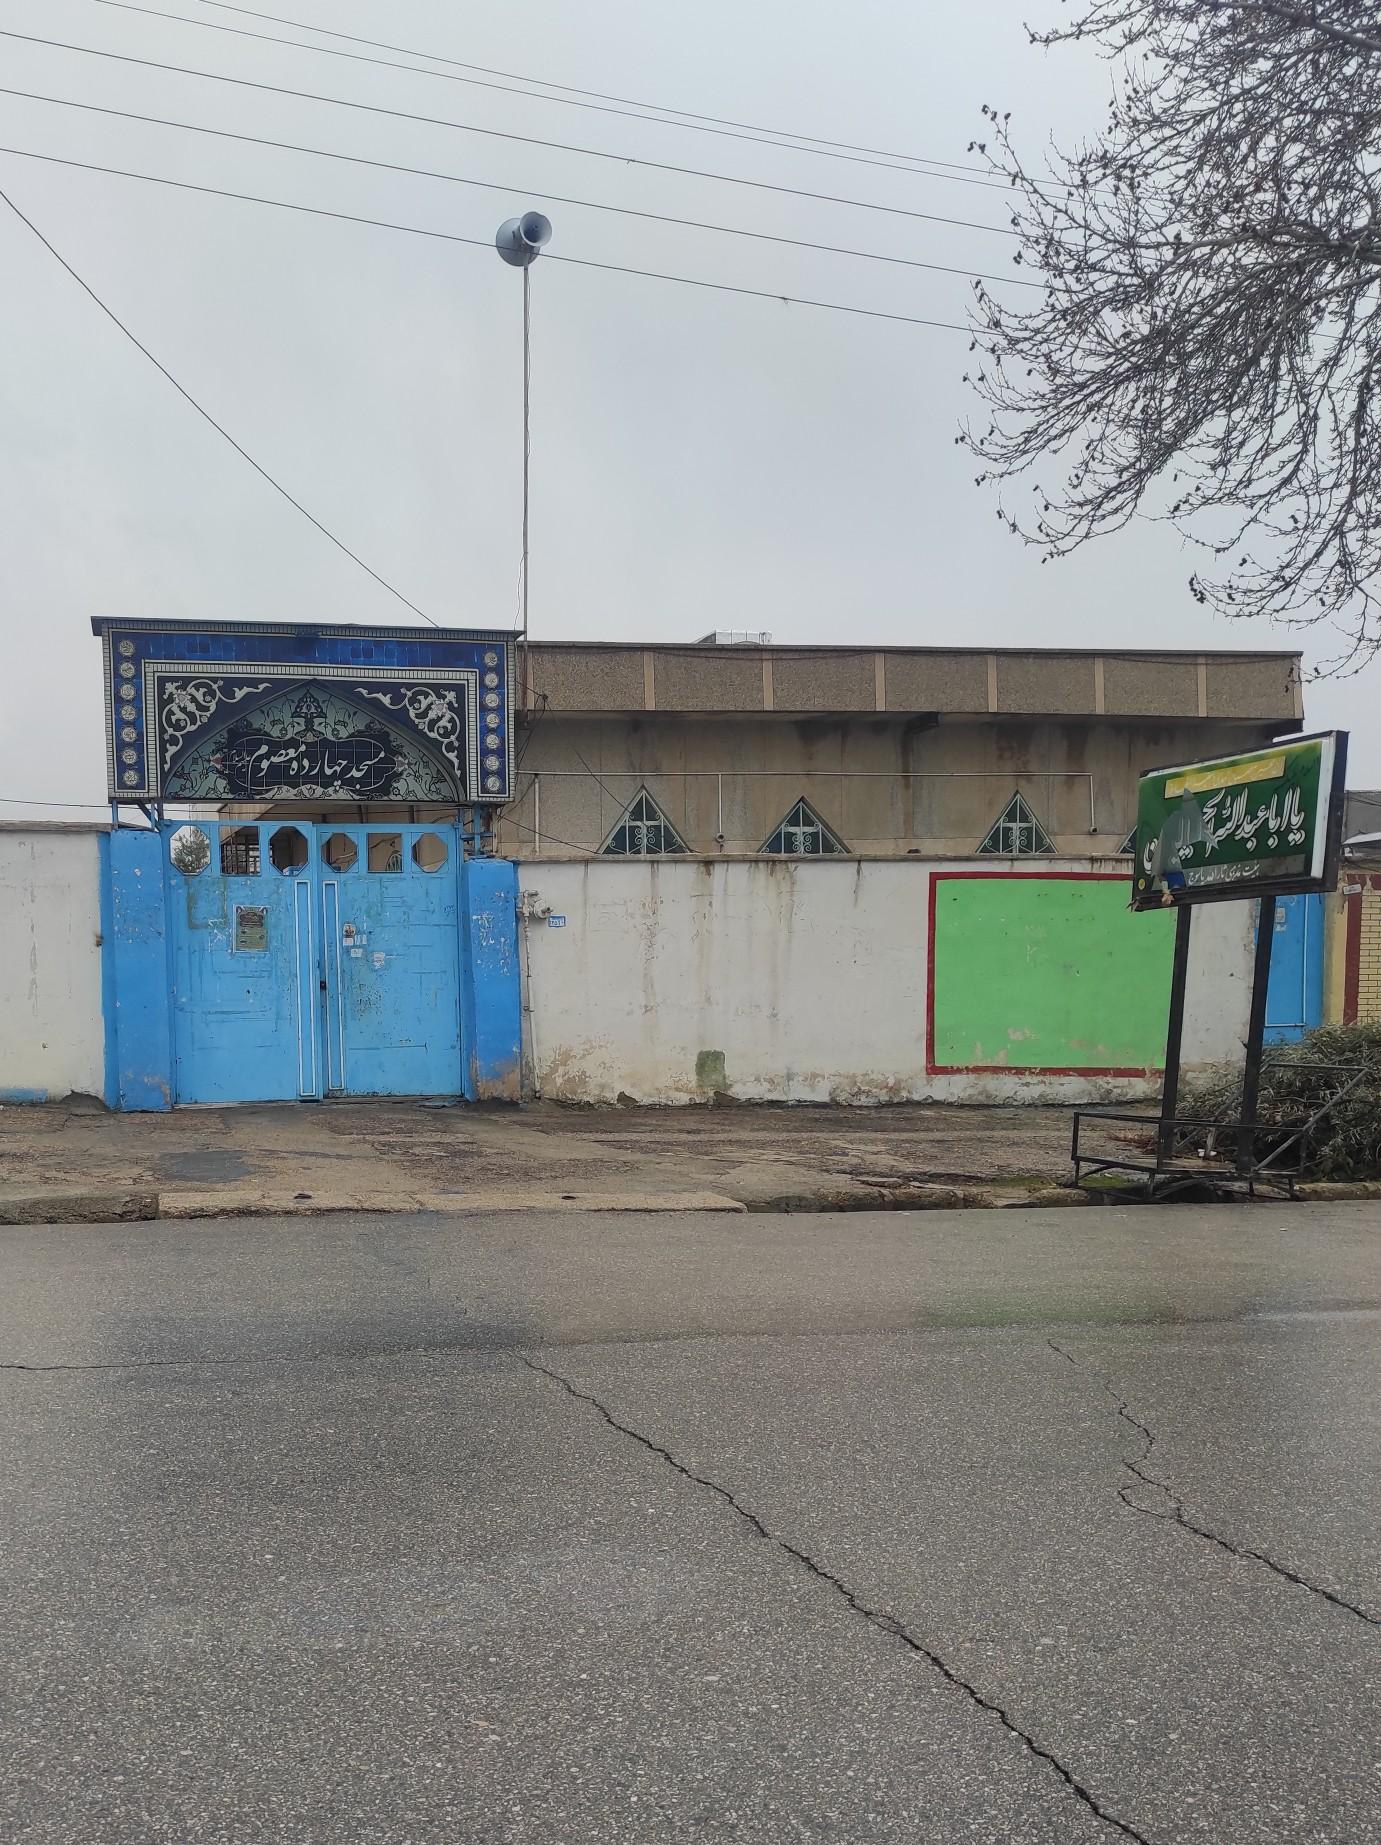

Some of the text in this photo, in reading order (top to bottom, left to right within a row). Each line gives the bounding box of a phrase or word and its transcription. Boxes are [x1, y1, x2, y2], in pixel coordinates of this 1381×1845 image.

[247, 743, 386, 797] مسجد چهارده معصوم
